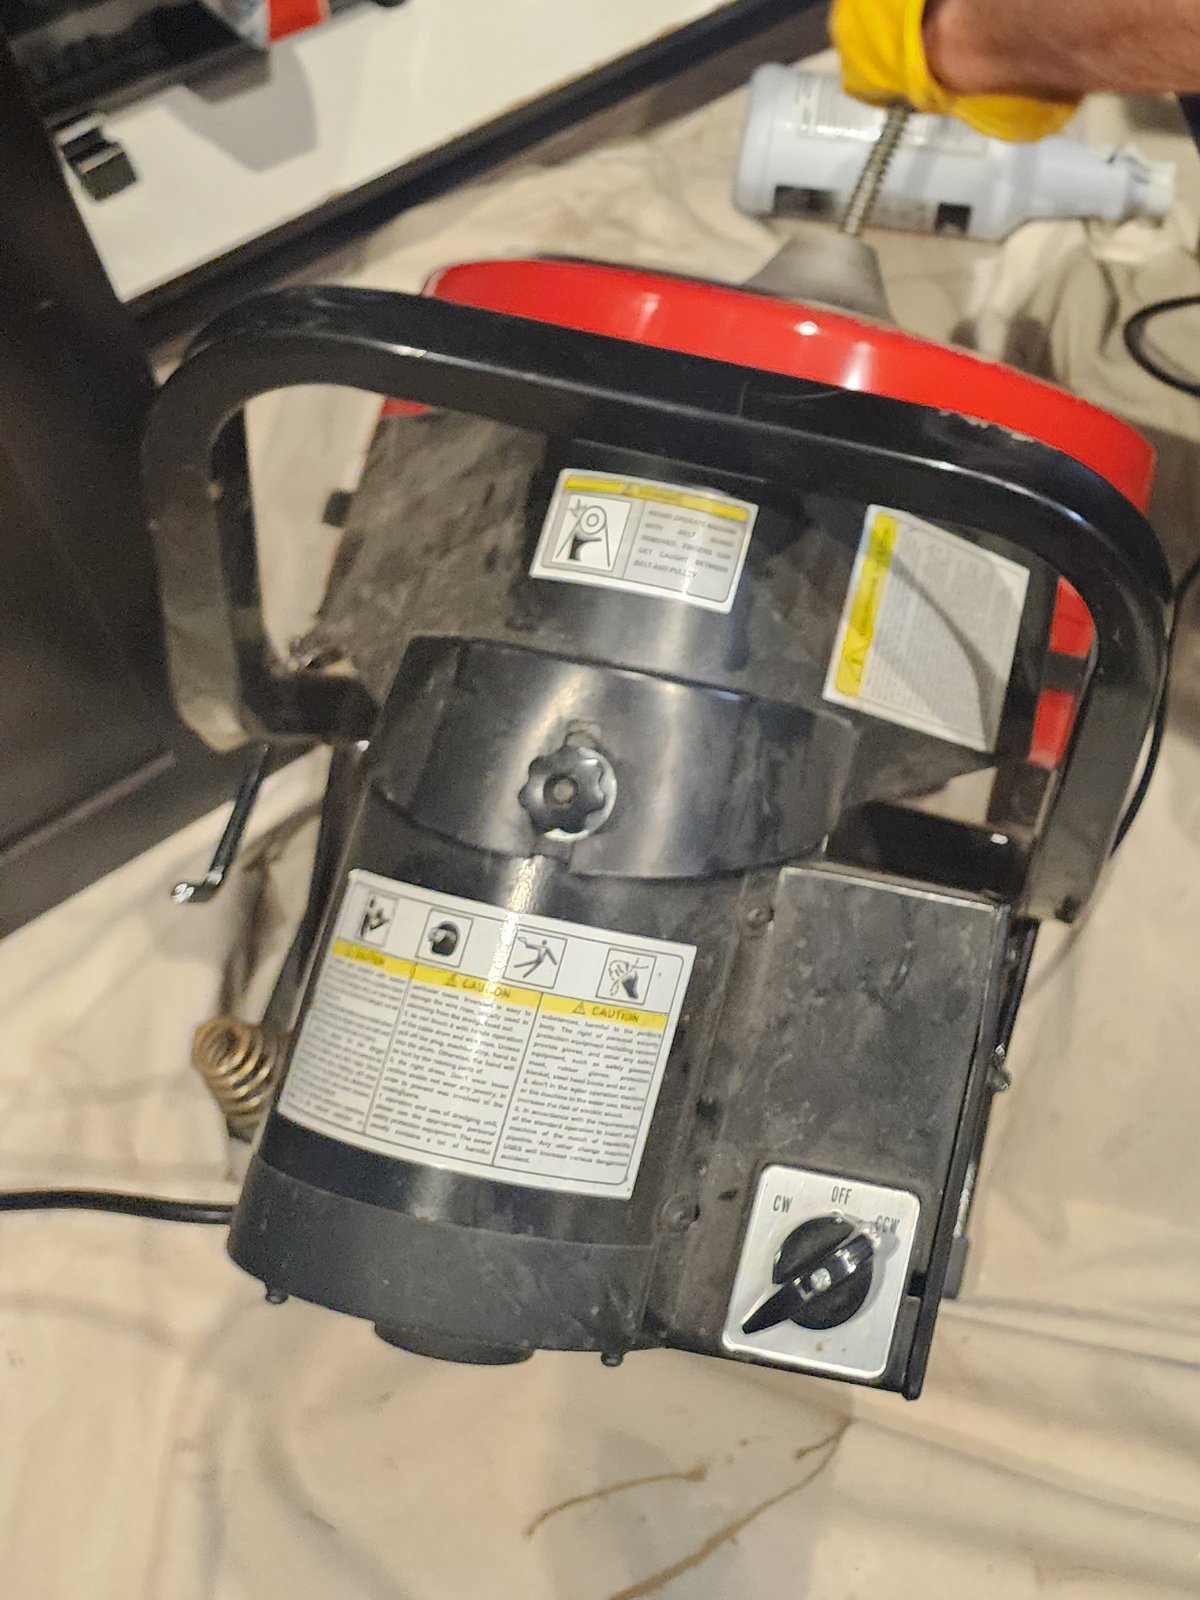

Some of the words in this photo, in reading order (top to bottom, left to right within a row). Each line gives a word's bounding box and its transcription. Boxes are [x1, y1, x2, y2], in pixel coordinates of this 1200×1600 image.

[462, 978, 511, 999] CAUON
[592, 1006, 640, 1023] CAUTION
[773, 1194, 793, 1213] CW
[831, 1185, 852, 1205] OFF
[875, 1215, 900, 1235] CCW
